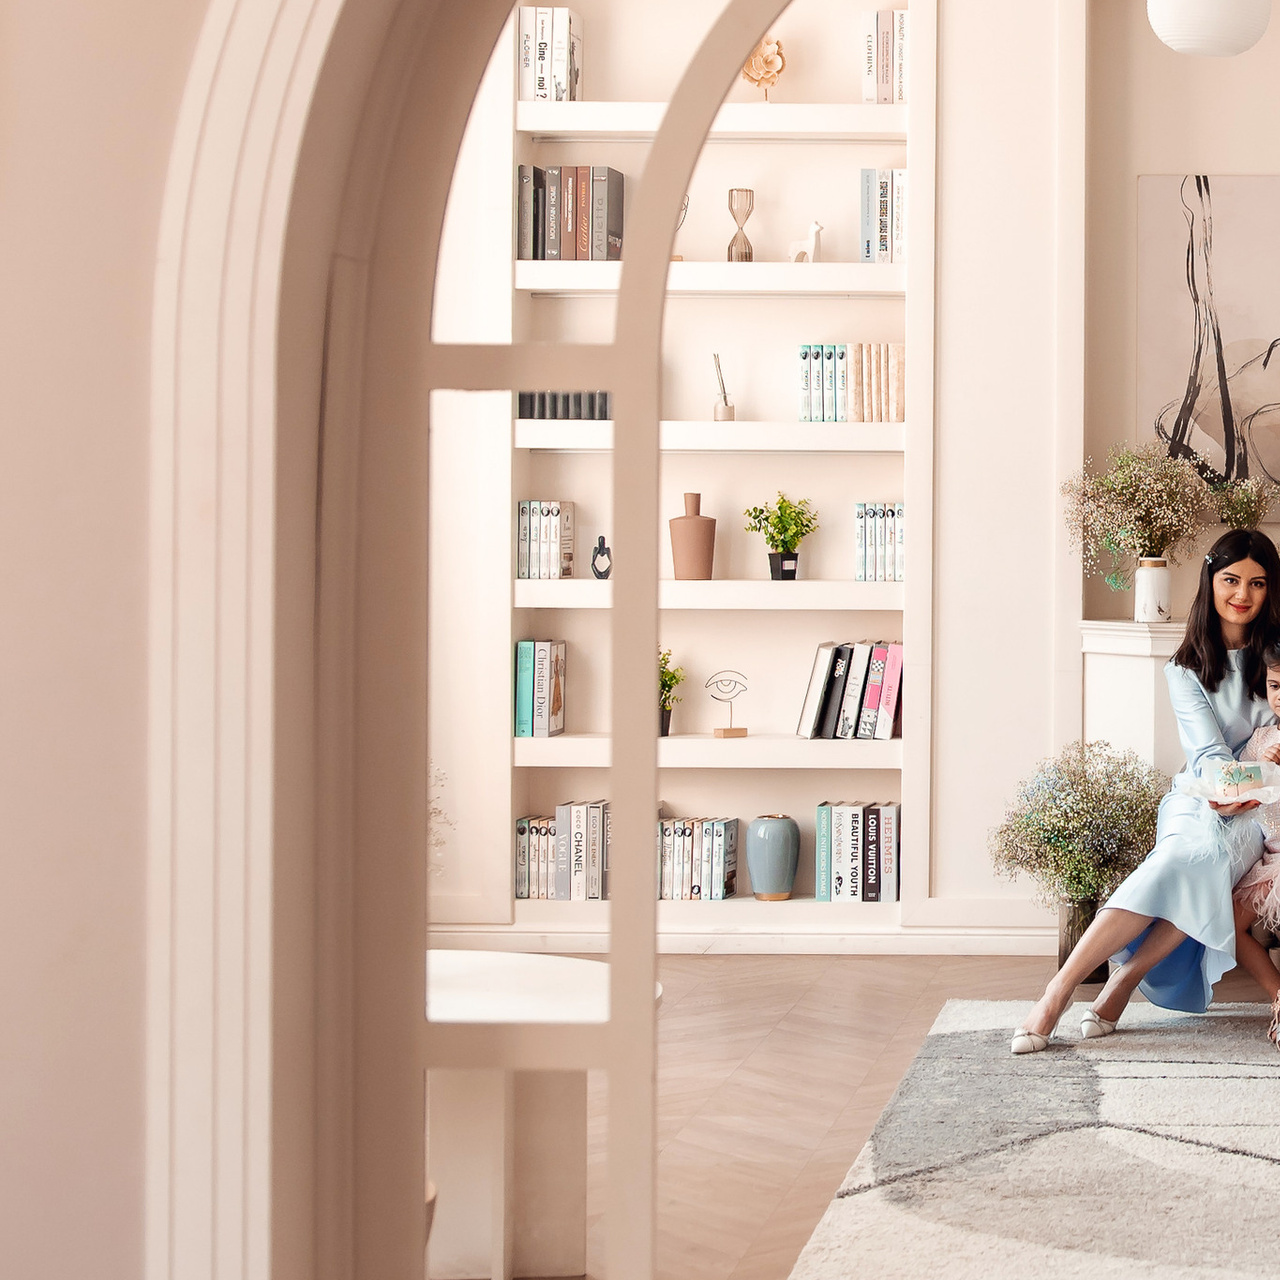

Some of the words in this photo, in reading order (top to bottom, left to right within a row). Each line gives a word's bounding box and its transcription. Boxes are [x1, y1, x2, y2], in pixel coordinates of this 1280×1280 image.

[538, 42, 548, 62] Cine
[538, 76, 547, 90] noi
[578, 213, 588, 252] Cartier
[595, 198, 604, 253] Arletta
[537, 648, 547, 684] Christian
[536, 686, 547, 719] Dior
[851, 813, 859, 863] BEAUTIFUL
[868, 814, 877, 842] LOUIS
[558, 833, 568, 873] VOGUE
[574, 831, 583, 877] CHANEL
[868, 843, 877, 884] VUITTON
[851, 865, 859, 897] YOUTH
